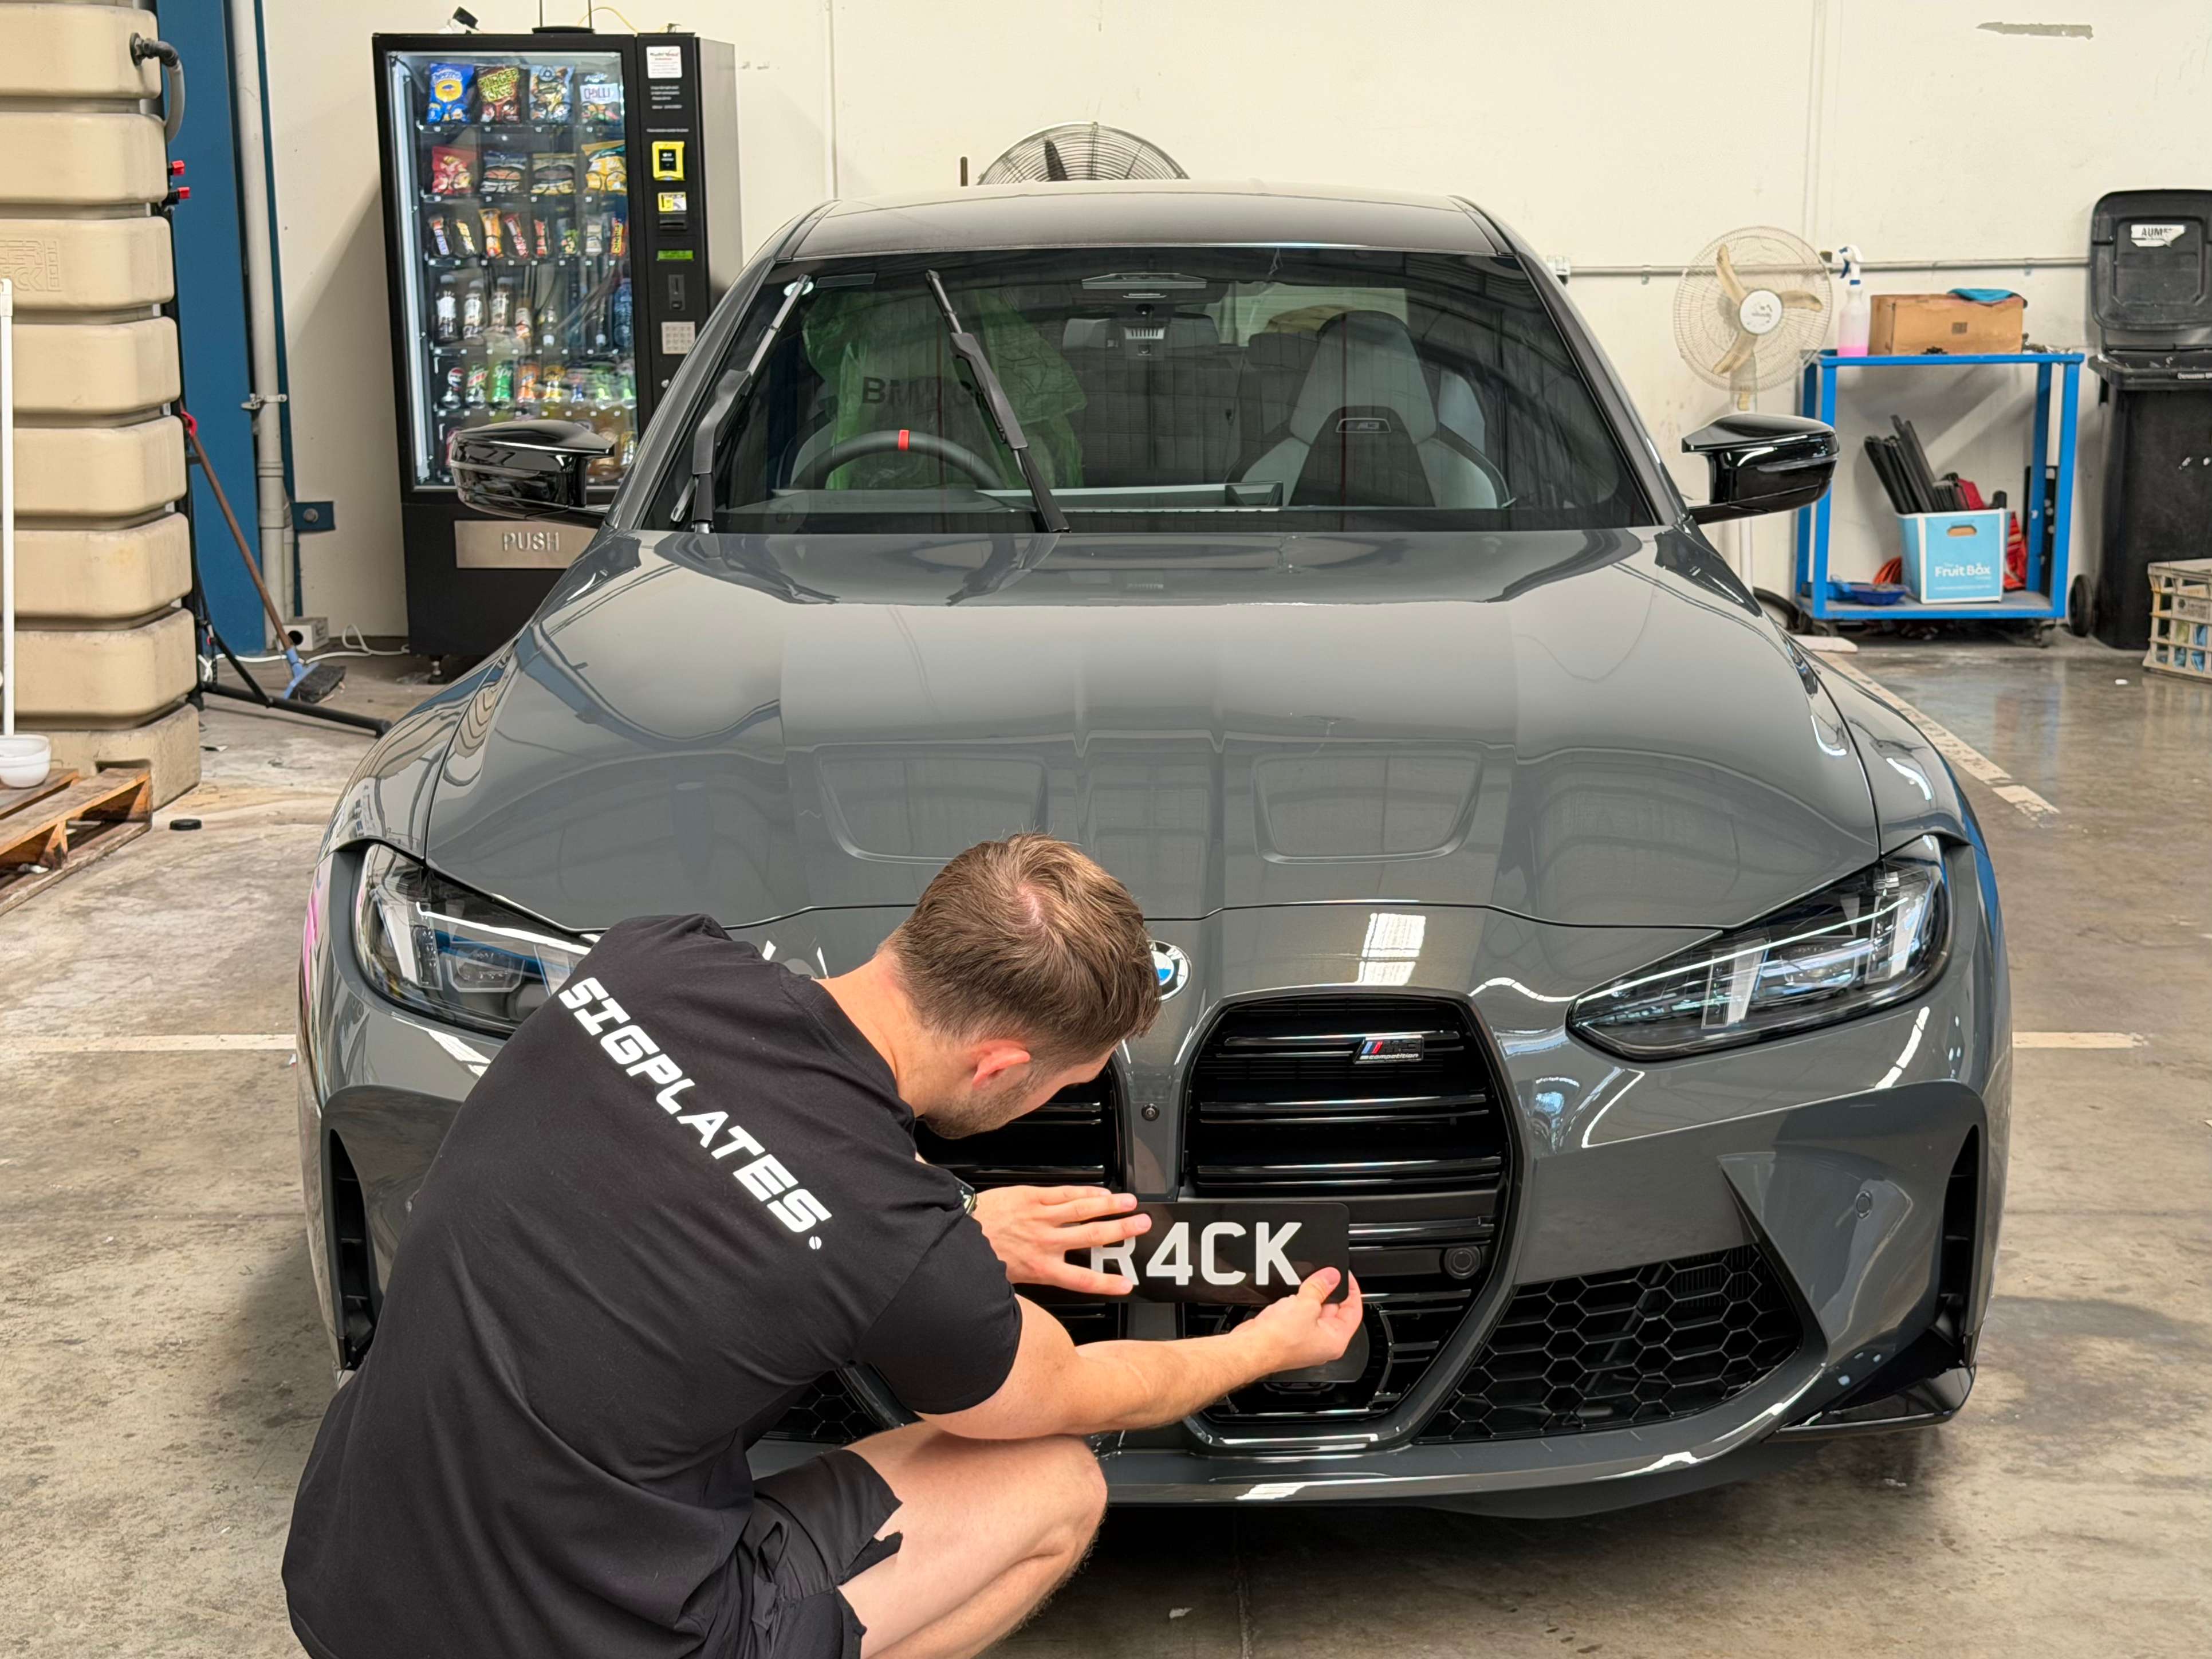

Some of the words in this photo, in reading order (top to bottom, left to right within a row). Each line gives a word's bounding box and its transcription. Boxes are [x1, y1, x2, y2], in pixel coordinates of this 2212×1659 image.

[502, 532, 560, 552] PUSH
[1934, 564, 1965, 577] Fruit
[1057, 1221, 1302, 1285] R4CK
